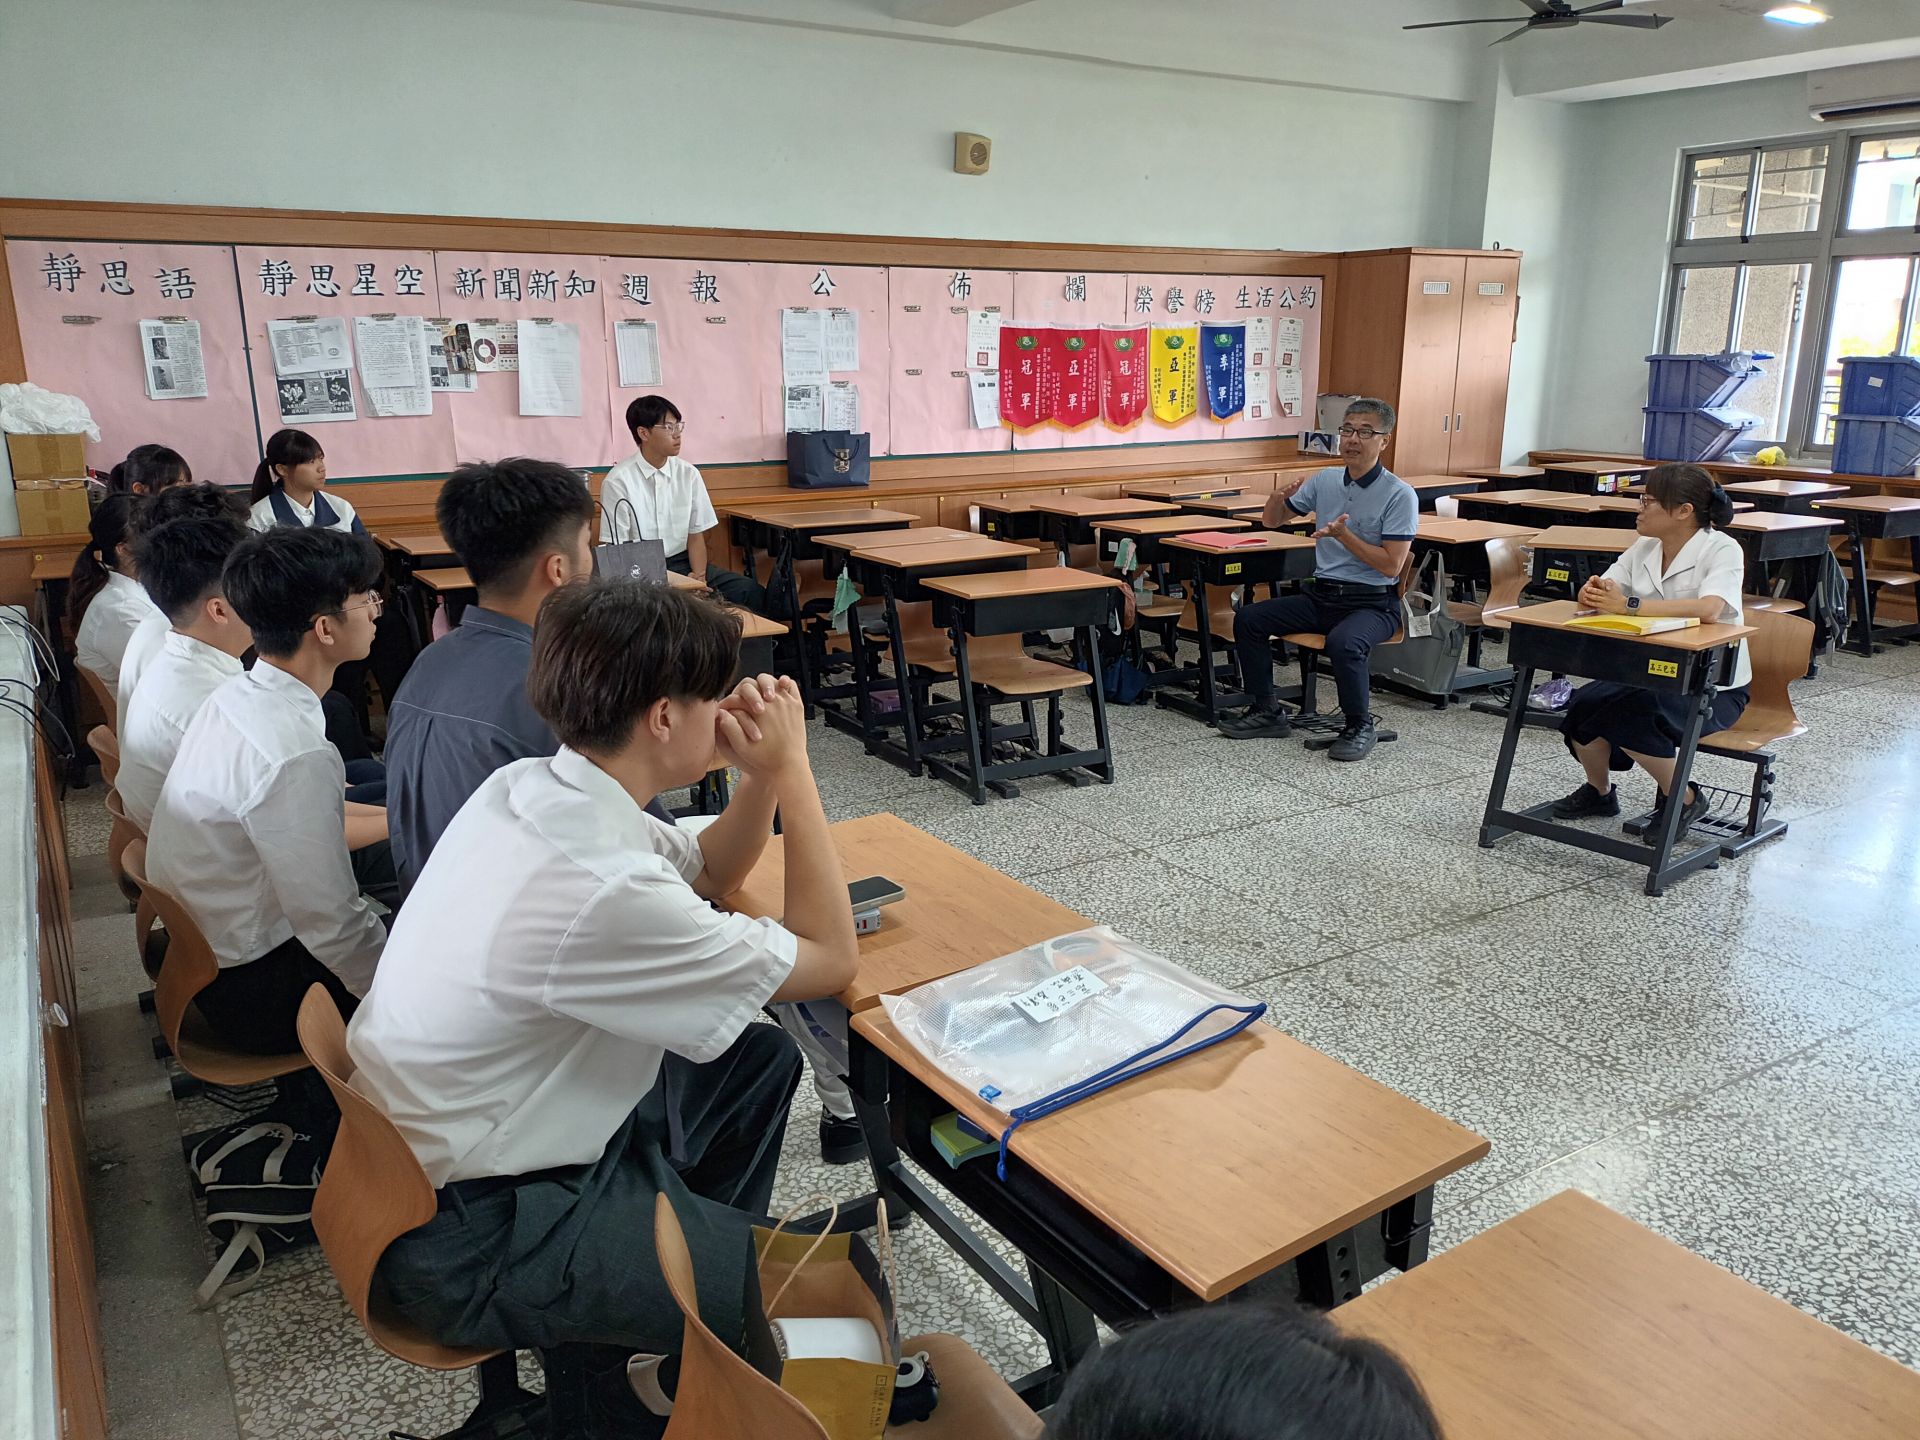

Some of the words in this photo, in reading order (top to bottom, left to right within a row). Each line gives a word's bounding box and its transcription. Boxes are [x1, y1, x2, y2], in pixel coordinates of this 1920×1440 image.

[40, 252, 197, 300] 靜思語
[258, 259, 426, 298] 靜思星空
[455, 267, 596, 302] 新聞新知
[623, 271, 720, 305] 週報
[1235, 284, 1317, 311] 生活公約
[1136, 286, 1215, 315] 榮譽榜
[1020, 359, 1033, 411] 冠軍
[1067, 359, 1080, 411] 亞軍
[1119, 360, 1131, 410] 冠軍
[1167, 356, 1180, 406] 亞軍
[1217, 353, 1229, 403] 季軍
